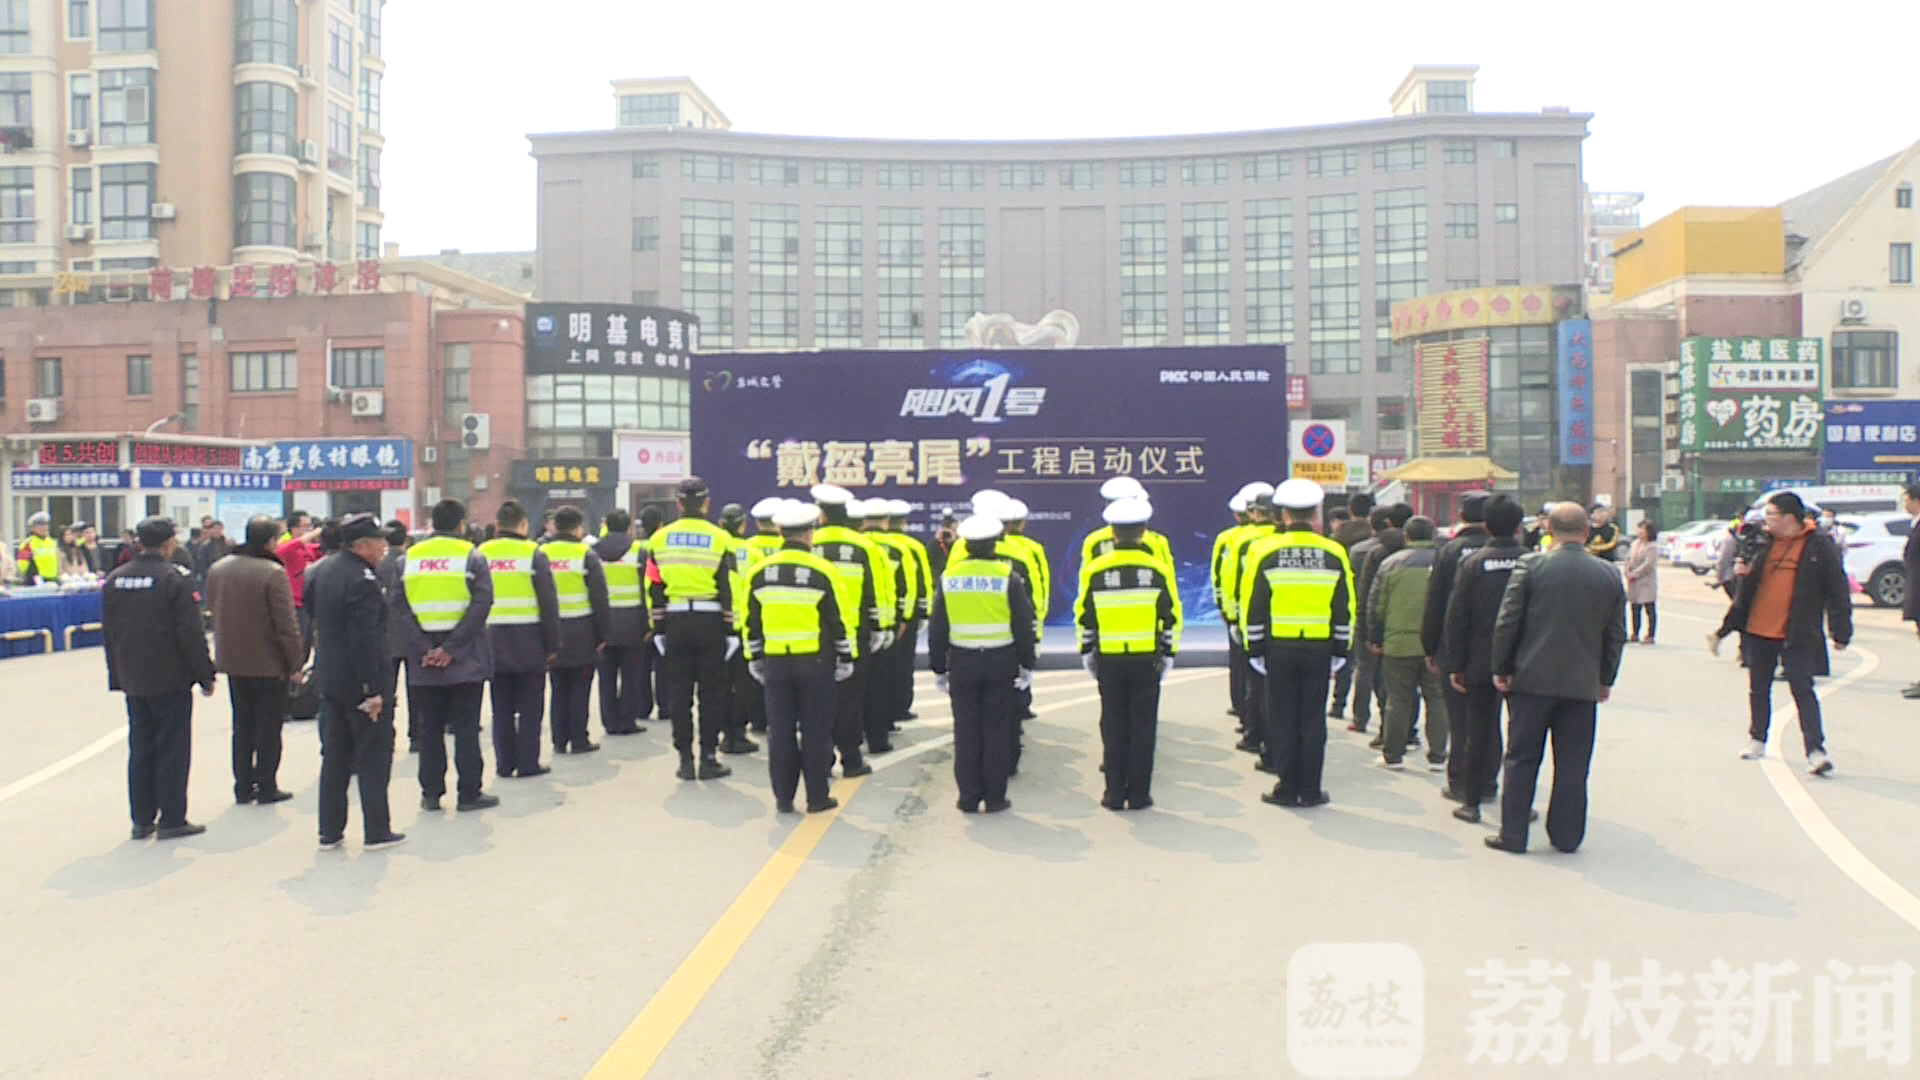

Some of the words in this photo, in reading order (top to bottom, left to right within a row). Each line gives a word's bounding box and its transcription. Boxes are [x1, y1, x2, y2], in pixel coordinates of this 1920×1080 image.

[1710, 340, 1819, 361] 盐城医药
[1160, 371, 1189, 383] PICC
[1190, 370, 1271, 382] 中国人民保险
[1736, 369, 1815, 383] 中国体育彩票
[900, 374, 1047, 421] 飓风1号
[1742, 395, 1825, 439] 药房
[245, 444, 400, 471] 南京吴良材眼镜
[419, 560, 450, 572] PICC
[489, 560, 516, 572] PICC
[1278, 559, 1325, 568] POLICE
